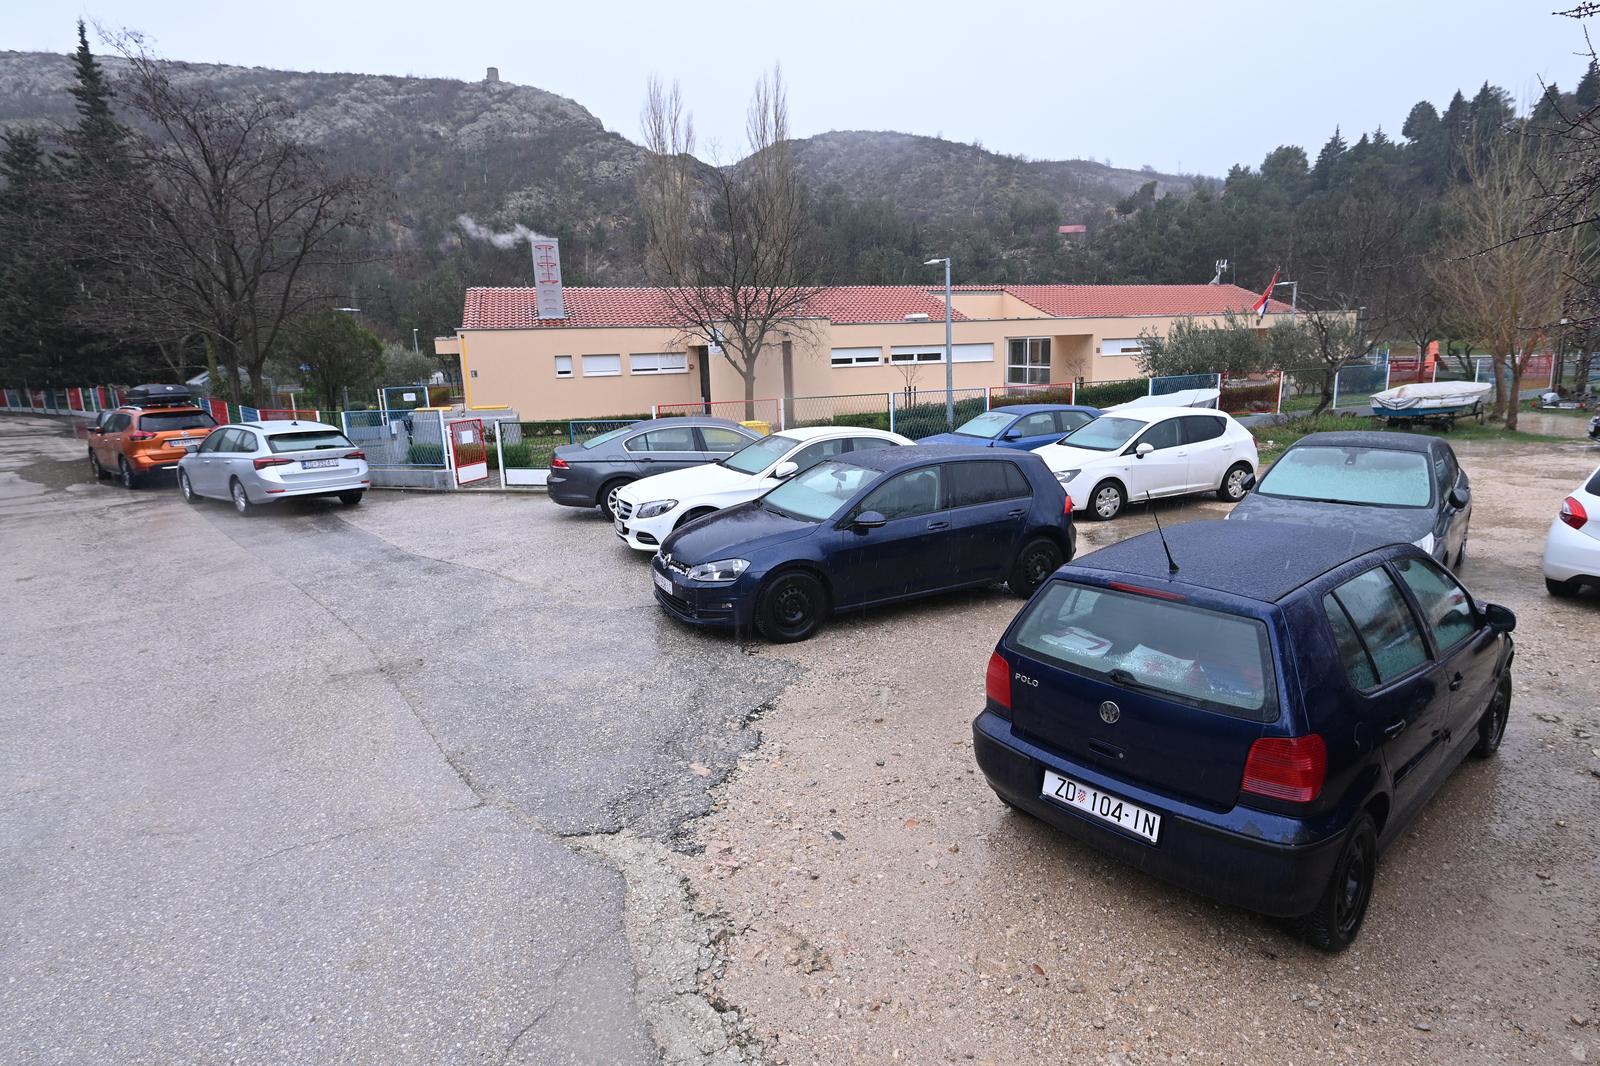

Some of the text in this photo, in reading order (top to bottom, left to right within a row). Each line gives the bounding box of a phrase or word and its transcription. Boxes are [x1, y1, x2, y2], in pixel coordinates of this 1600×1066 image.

[1015, 672, 1039, 687] POLO
[1055, 777, 1156, 836] ZD 104-IN
